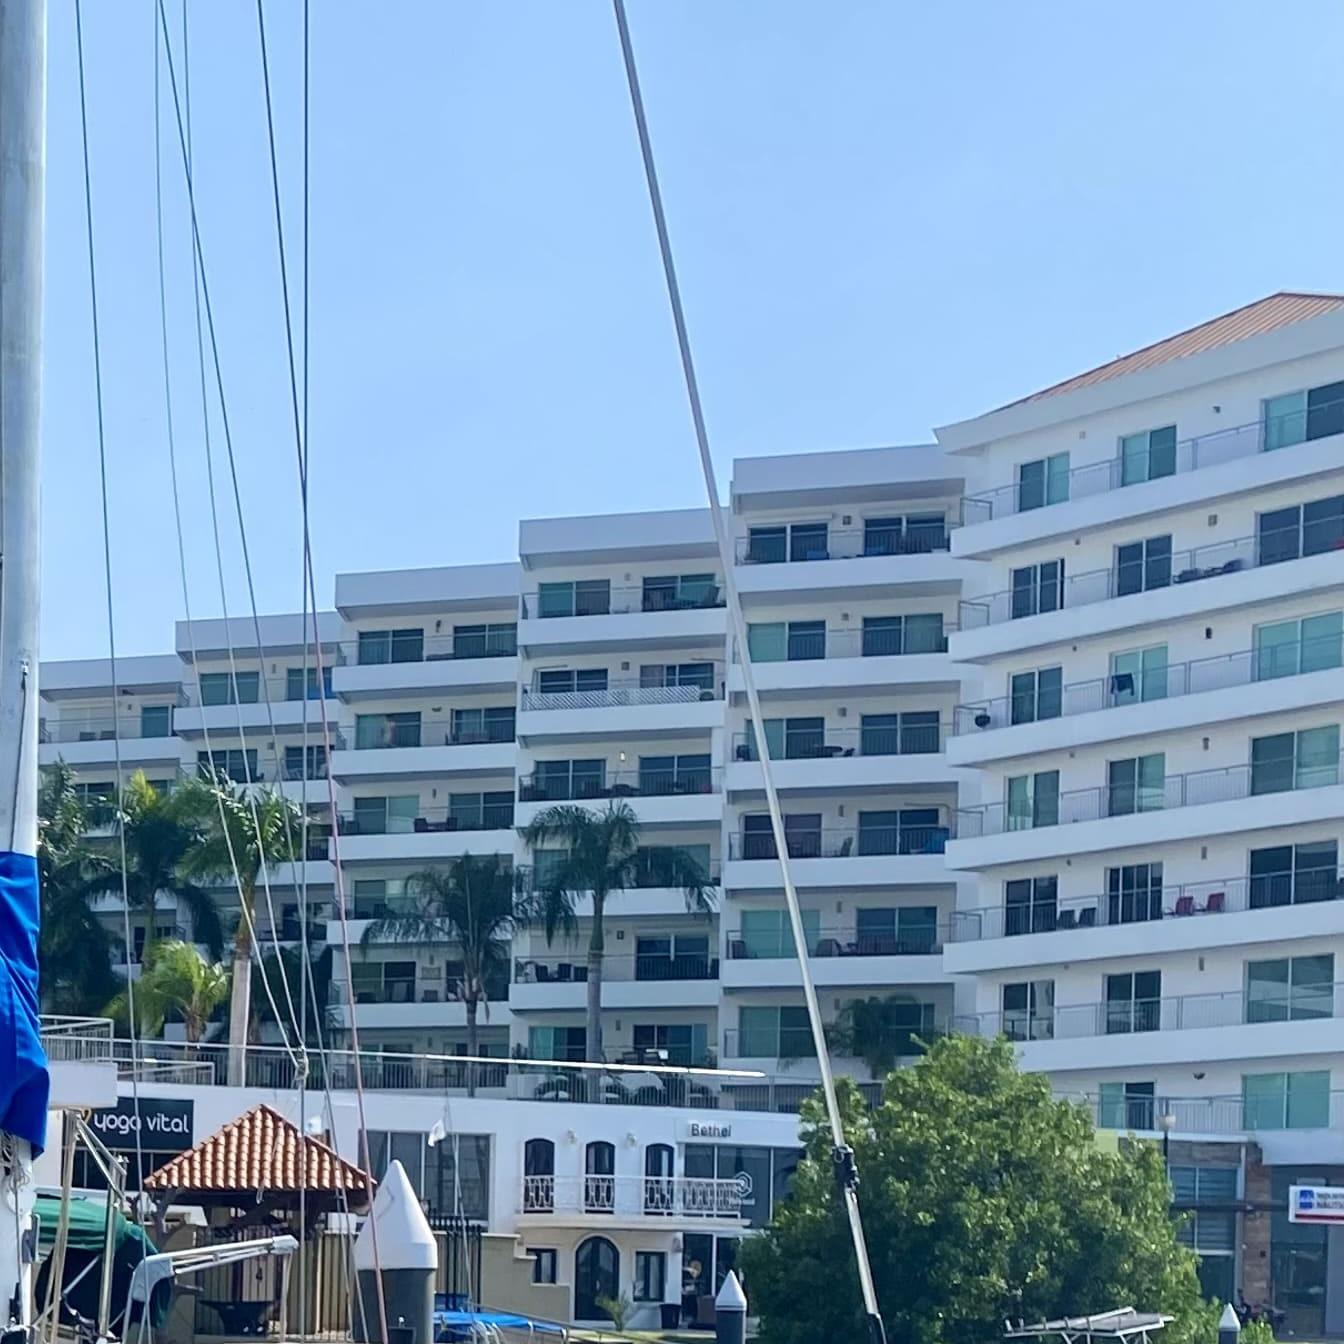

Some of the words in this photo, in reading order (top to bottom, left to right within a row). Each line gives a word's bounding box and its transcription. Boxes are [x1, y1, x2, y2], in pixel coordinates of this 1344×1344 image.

[94, 1113, 141, 1135] yoga
[146, 1112, 190, 1133] vital
[691, 1123, 732, 1138] Bethel
